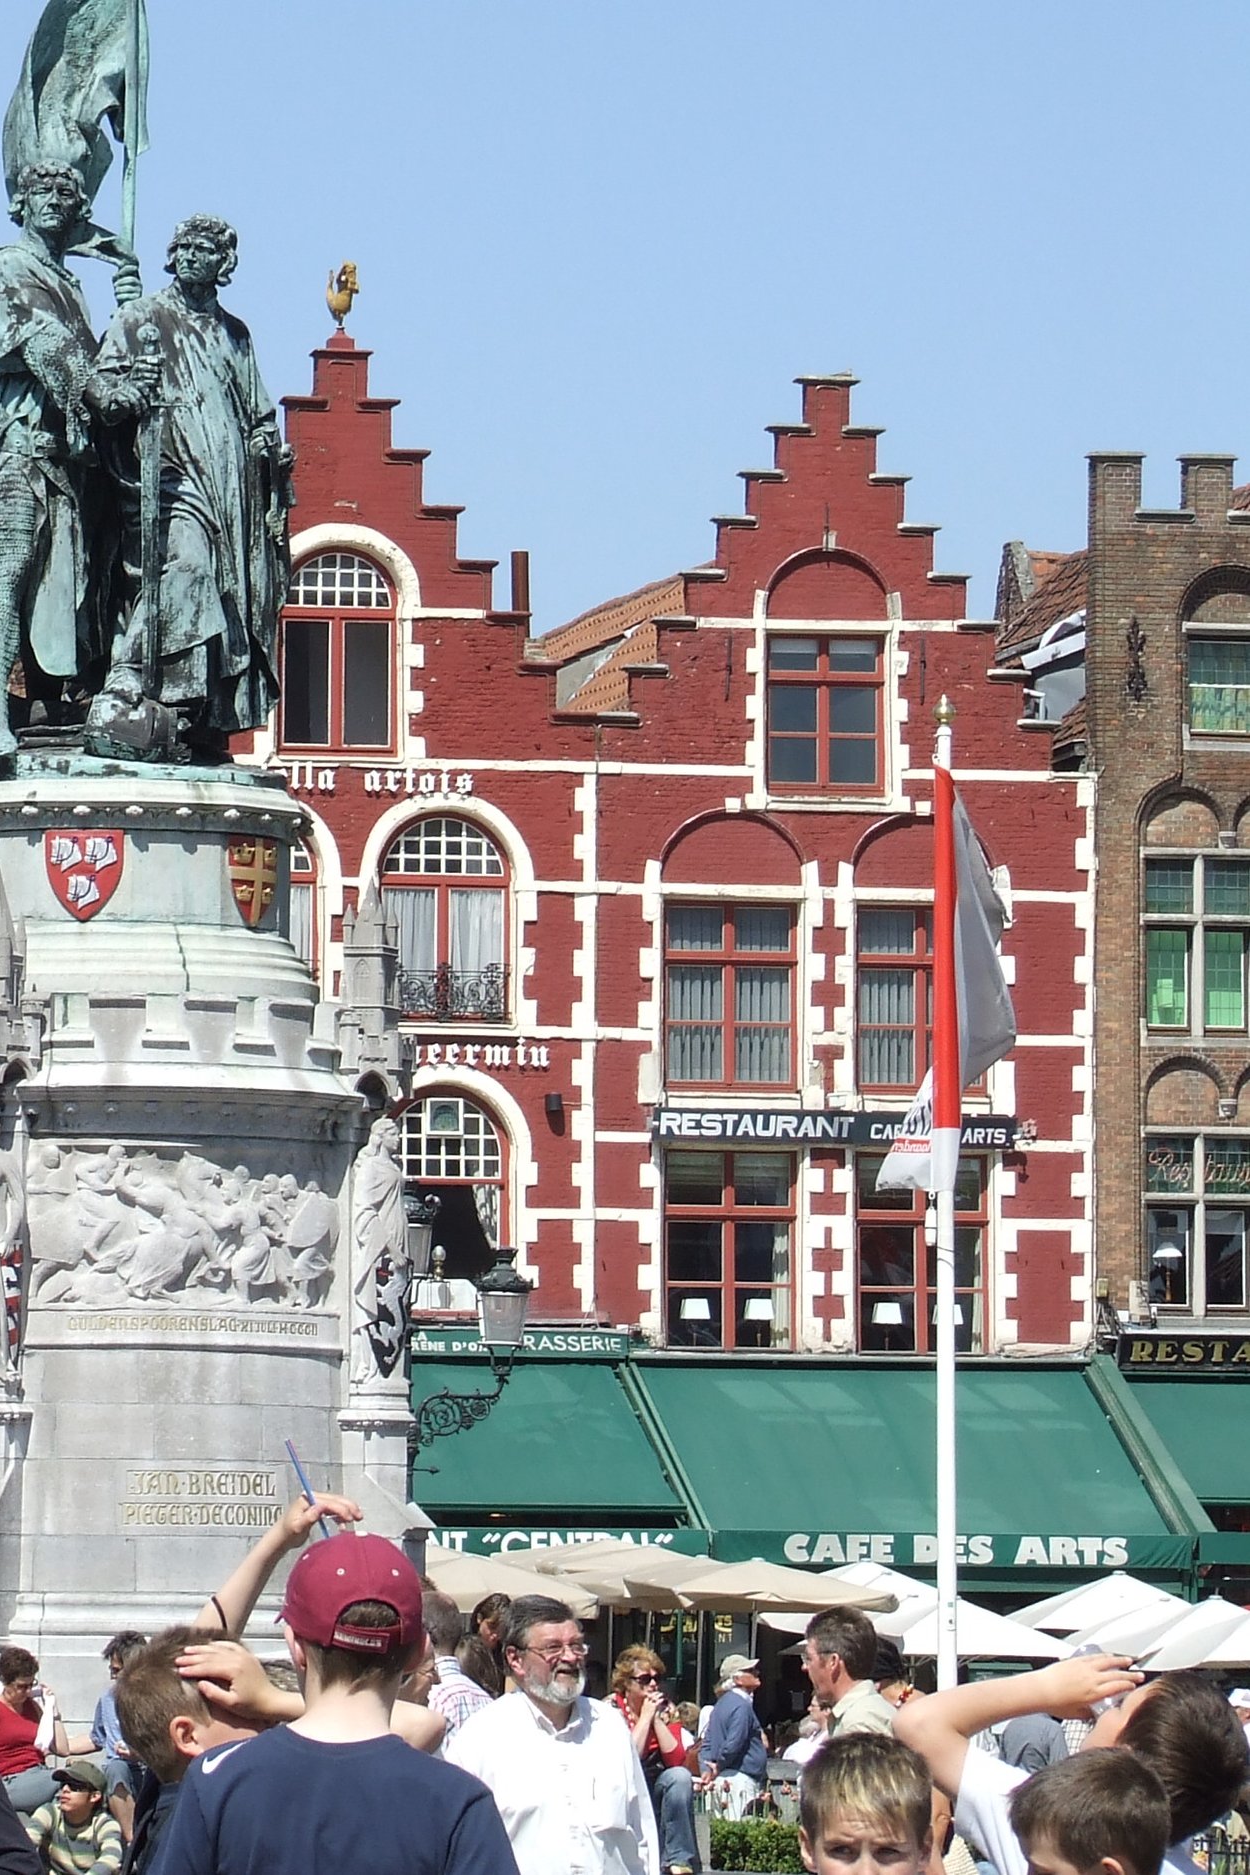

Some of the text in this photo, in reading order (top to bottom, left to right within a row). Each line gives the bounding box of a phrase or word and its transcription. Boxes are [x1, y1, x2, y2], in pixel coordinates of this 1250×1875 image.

[364, 768, 474, 794] artois
[659, 1112, 855, 1138] RESTAURANT
[411, 1341, 446, 1352] RENE
[522, 1334, 622, 1352] RASSERIE
[783, 1533, 894, 1563] CAFE
[1013, 1536, 1129, 1566] ARTS
